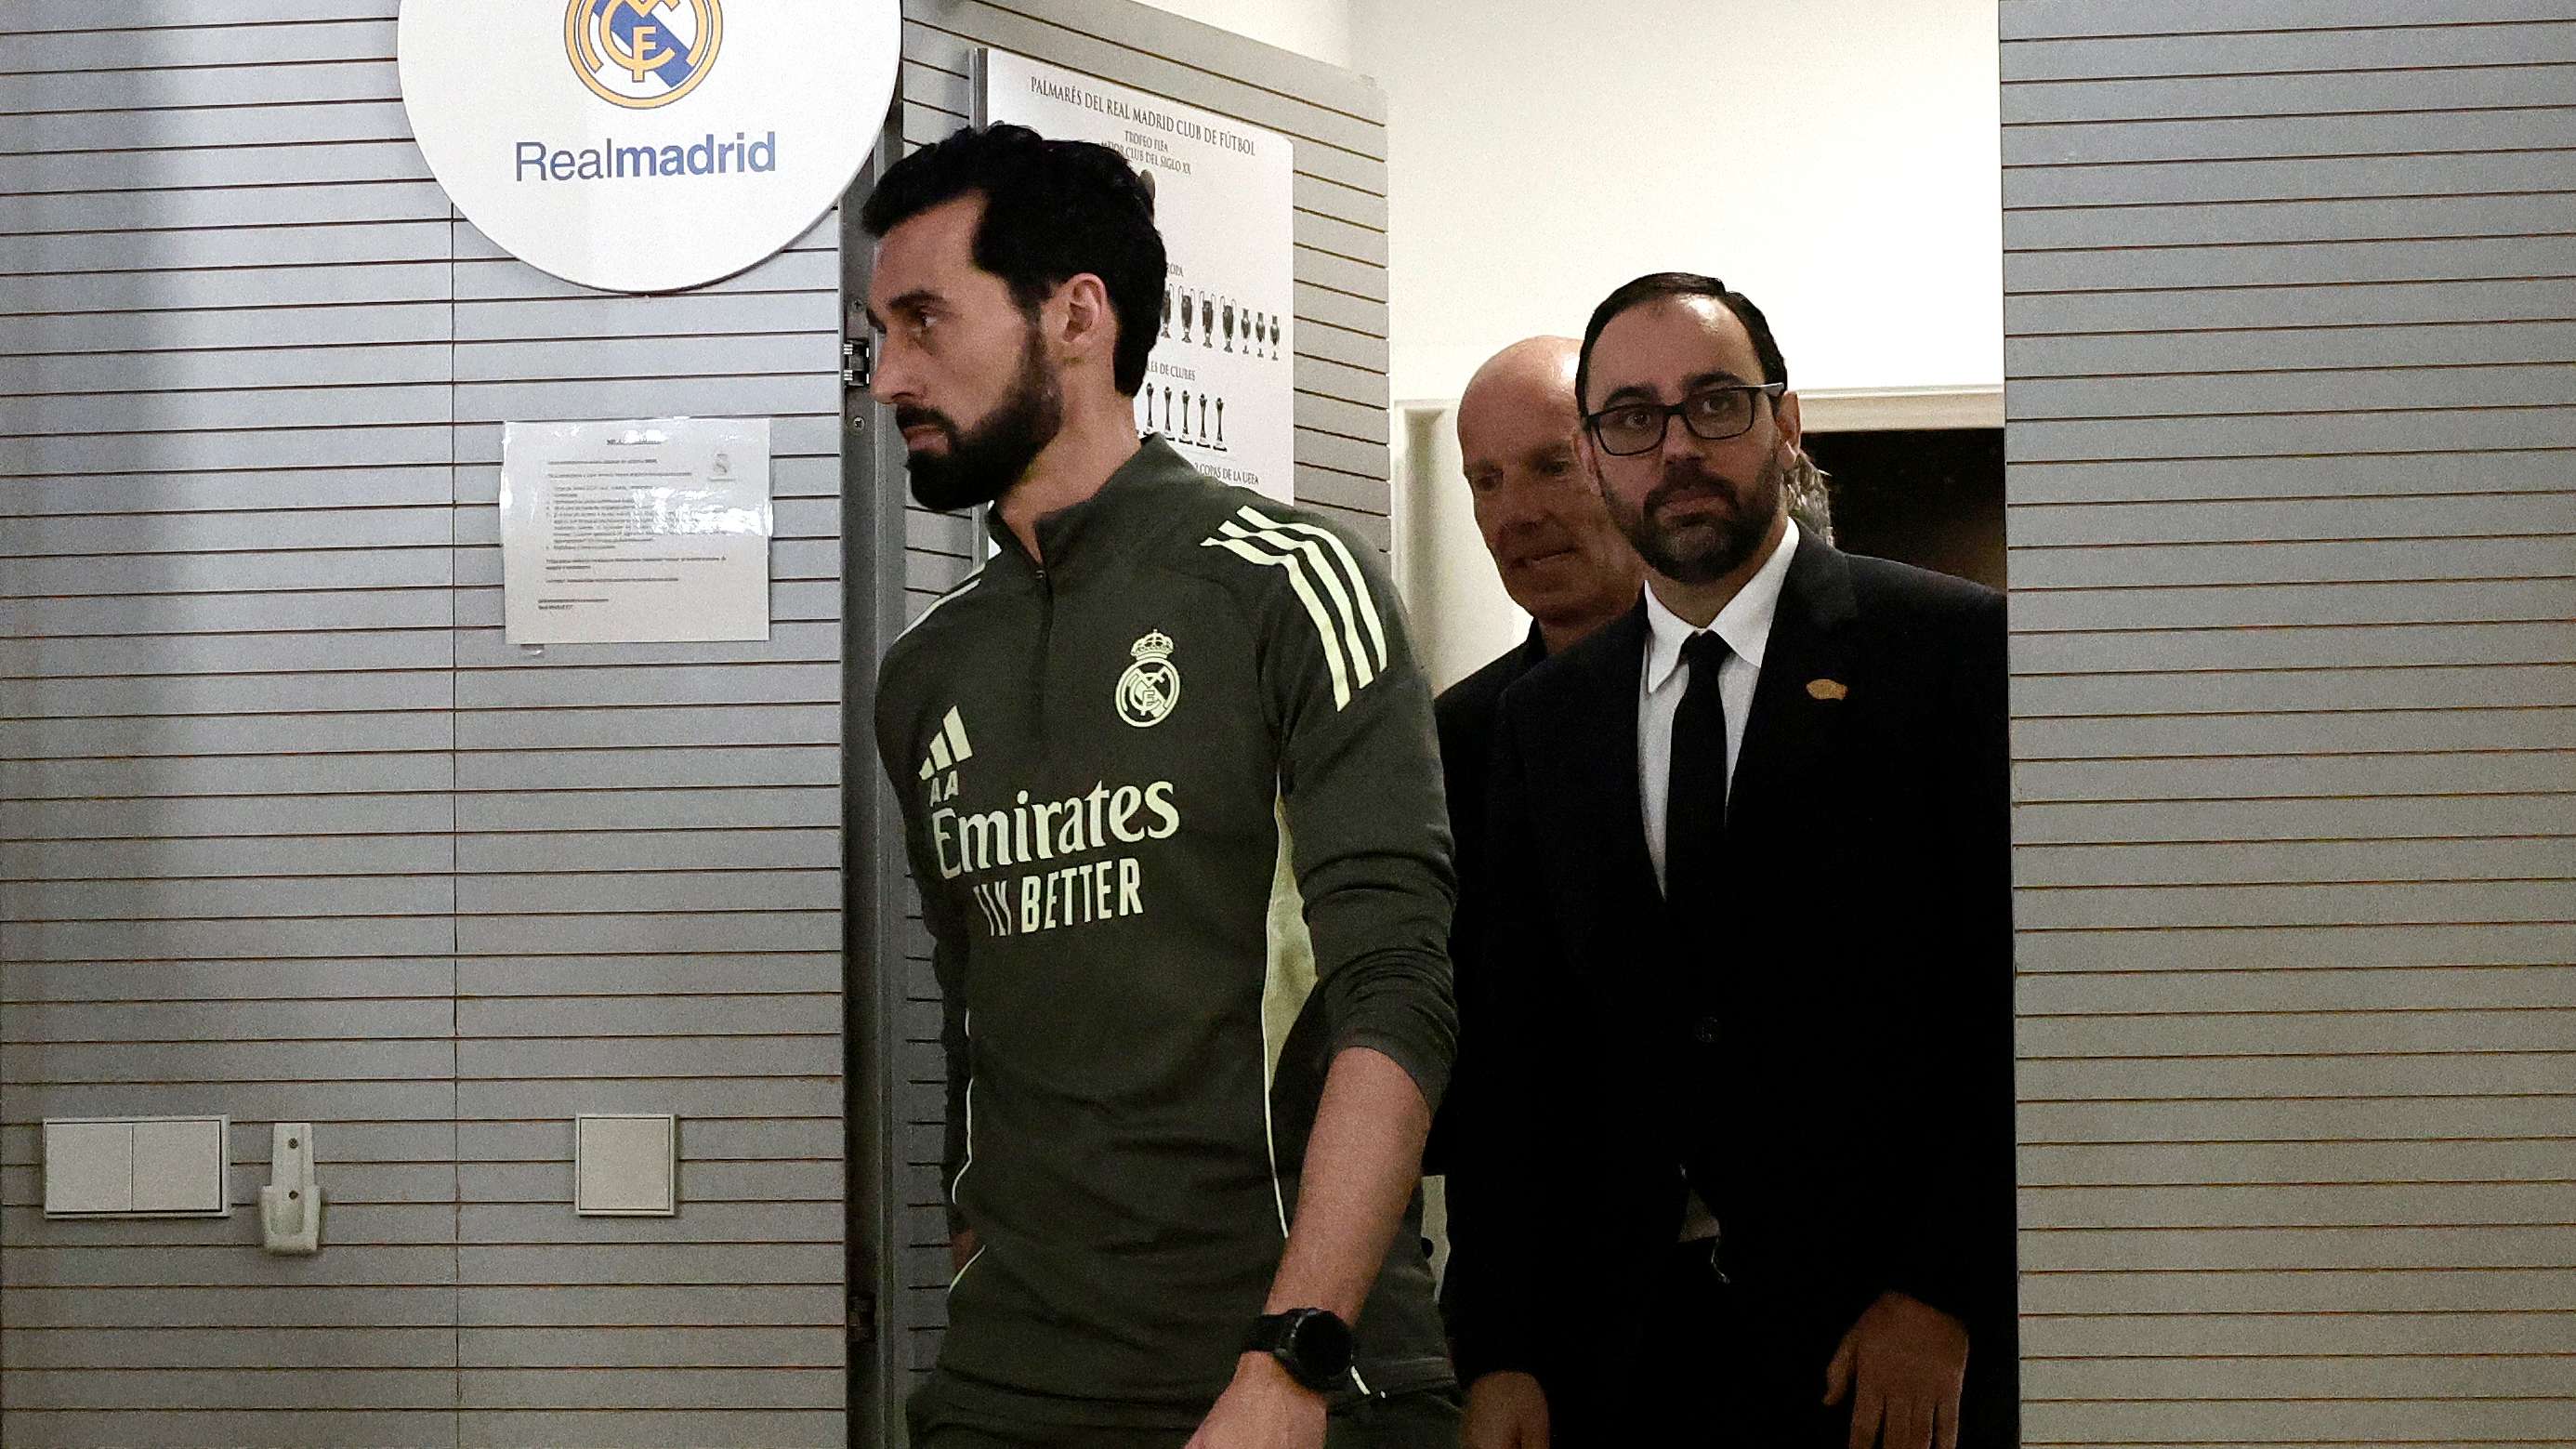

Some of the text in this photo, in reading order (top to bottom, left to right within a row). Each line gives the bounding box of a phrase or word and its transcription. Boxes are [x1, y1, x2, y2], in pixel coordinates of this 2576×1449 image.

[1031, 76, 1256, 156] PALMARÉS DEL REAL MADRID CLUB DE FÚTBOL
[1124, 130, 1153, 149] TROFEO
[516, 131, 776, 182] Realmadrid
[1125, 147, 1145, 162] CLUB
[1145, 151, 1159, 166] DEL
[1160, 155, 1181, 172] SIGLO
[1182, 161, 1191, 175] XX
[1200, 464, 1221, 479] COPAS
[1222, 468, 1233, 481] DE
[1233, 470, 1242, 482] LA
[932, 781, 1180, 879] Emirates
[1021, 857, 1144, 934] BETTER
